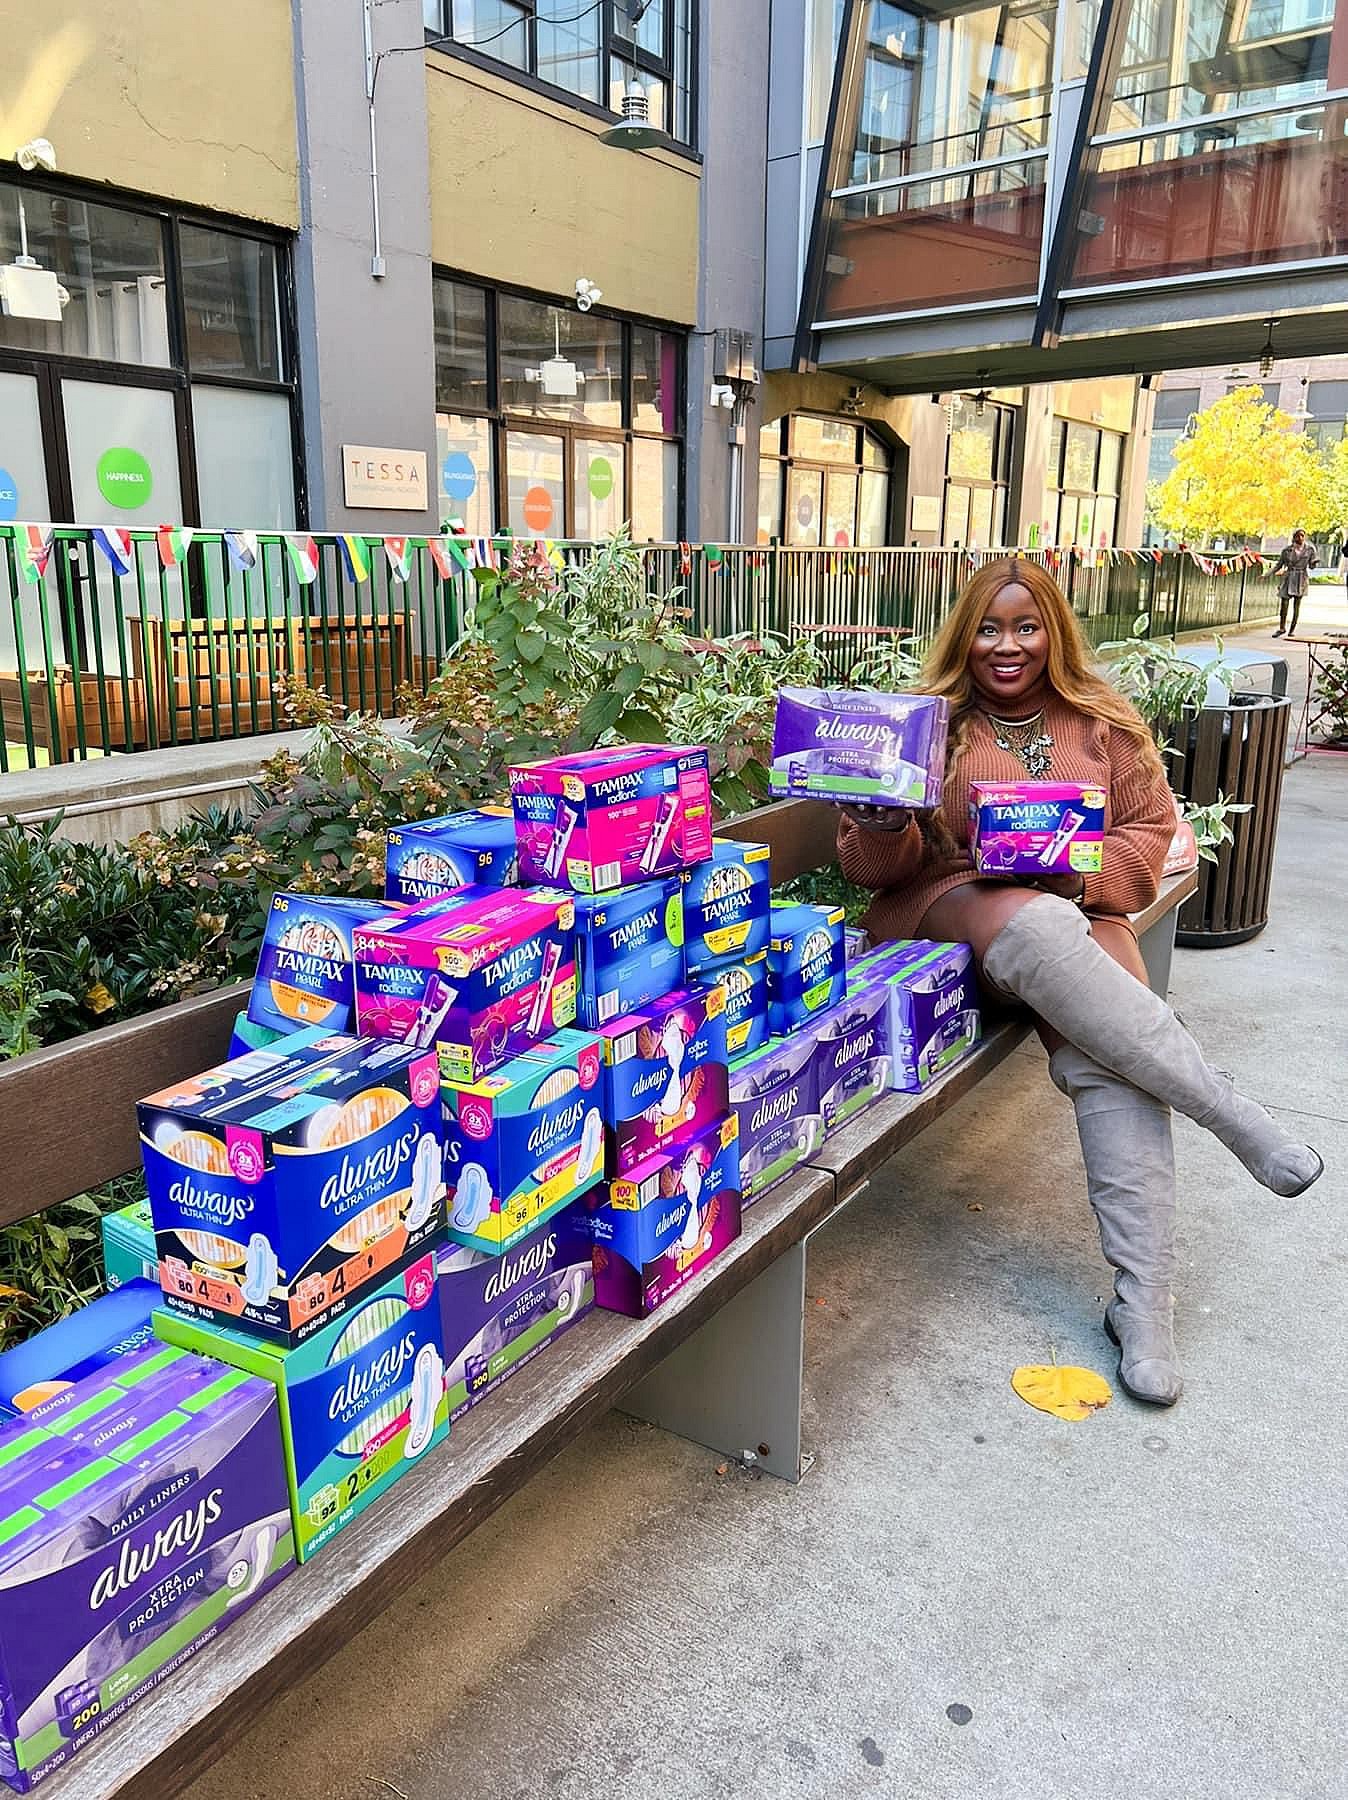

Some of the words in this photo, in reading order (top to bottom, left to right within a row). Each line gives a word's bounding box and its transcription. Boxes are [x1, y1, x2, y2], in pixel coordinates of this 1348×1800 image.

[352, 460, 419, 483] TESSA
[815, 714, 892, 748] always
[592, 770, 644, 797] TAMPAX
[515, 795, 556, 810] TAMPAX
[994, 804, 1061, 820] TAMPAX
[1011, 819, 1048, 830] radiant
[388, 832, 403, 846] 96
[478, 853, 493, 867] 96
[398, 878, 458, 898] TAMPA
[272, 896, 289, 913] 96
[701, 890, 753, 922] TAMPAX
[594, 913, 607, 927] 96
[609, 909, 659, 949] TAMPAX
[357, 936, 376, 951] 84
[471, 949, 487, 964] 84
[783, 940, 793, 953] 96
[275, 950, 345, 982] TAMPAX
[361, 963, 425, 985] TAMPAX
[482, 937, 543, 986] TAMPAX
[800, 949, 833, 984] TAMPAX
[724, 990, 753, 1017] MPAX
[933, 984, 966, 1020] always
[462, 1049, 470, 1059] R
[834, 1029, 875, 1069] always
[463, 1065, 470, 1075] S
[631, 1067, 668, 1098] always
[750, 1085, 800, 1133] always
[529, 1098, 586, 1152] always
[320, 1123, 421, 1209] always
[169, 1176, 255, 1226] always
[334, 1192, 364, 1216] ULTRA
[364, 1177, 387, 1202] THIN
[615, 1185, 631, 1198] 100
[180, 1206, 204, 1221] ULTRA
[204, 1212, 223, 1226] THIN
[516, 1208, 527, 1223] 96
[655, 1201, 687, 1238] always
[331, 1266, 346, 1294] 4
[484, 1232, 558, 1304] always
[178, 1279, 193, 1294] 80
[199, 1279, 210, 1301] 4
[309, 1291, 325, 1309] 80
[515, 1290, 534, 1308] XTRA
[331, 1301, 347, 1318] PADS
[504, 1288, 547, 1328] PROTECTION
[328, 1330, 416, 1421] always
[472, 1371, 489, 1391] 200
[31, 1391, 76, 1421] always
[341, 1391, 371, 1424] ULTRA
[371, 1378, 393, 1401] THIN
[93, 1415, 138, 1448] always
[347, 1472, 360, 1502] 2
[110, 1505, 146, 1537] DAILY
[149, 1473, 192, 1511] LINERS
[321, 1501, 337, 1521] 92
[339, 1506, 355, 1525] PADS
[88, 1487, 224, 1611] always
[127, 1568, 205, 1634] PROTECTION
[149, 1573, 183, 1605] XTRA
[72, 1727, 96, 1751] LINERS
[157, 1645, 196, 1684] PROTECTORES
[72, 1702, 101, 1731] 200
